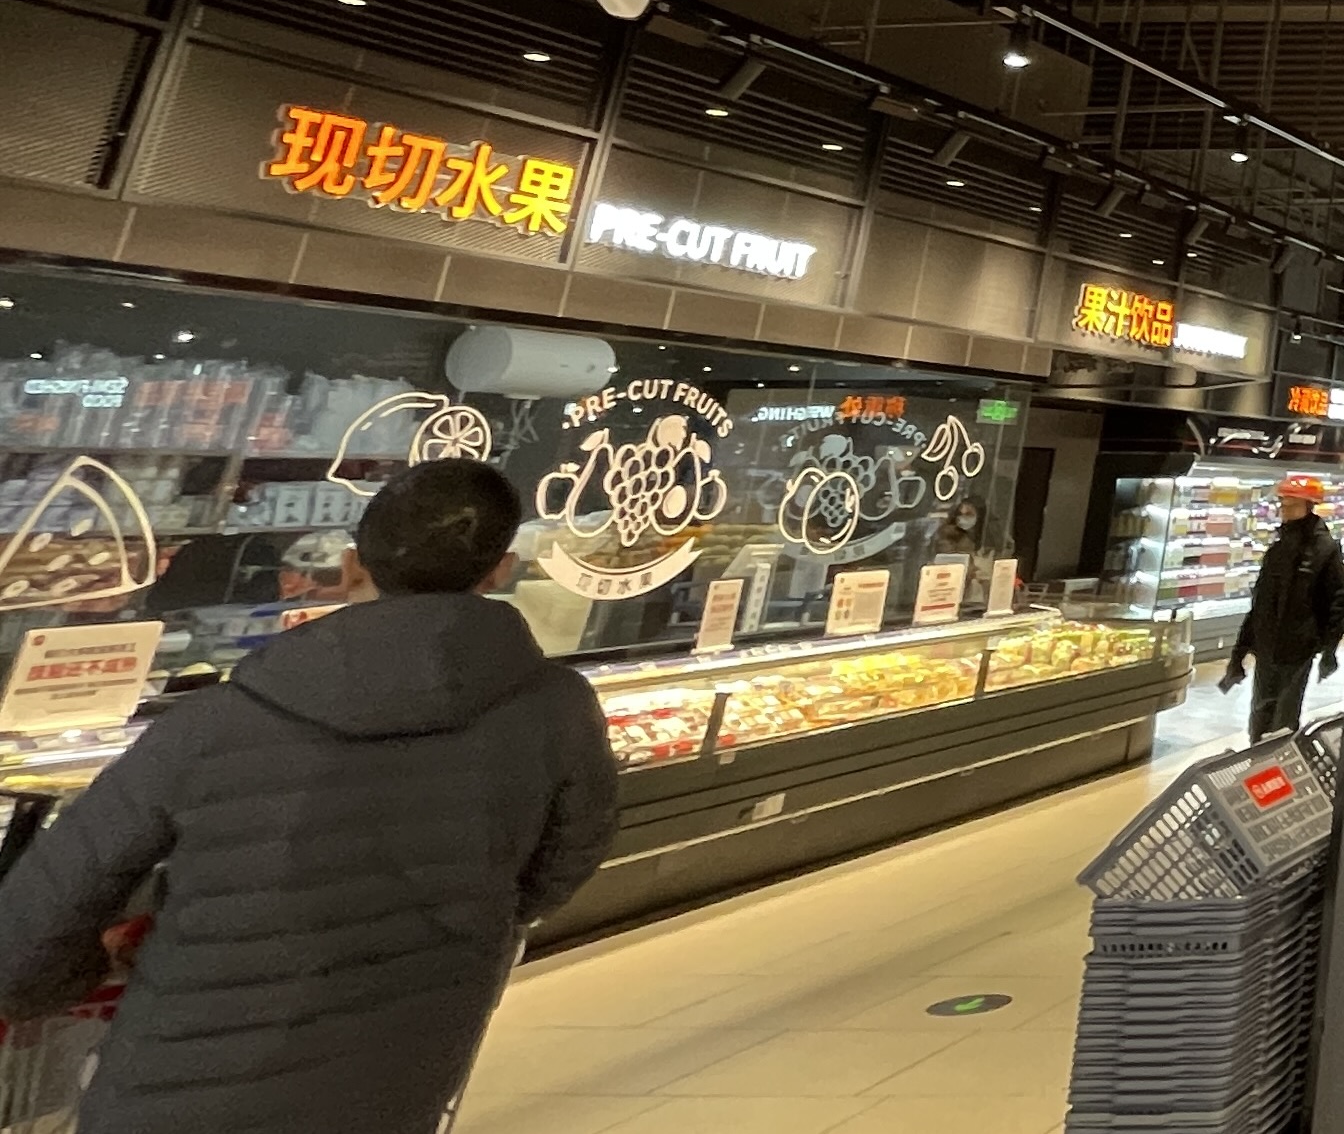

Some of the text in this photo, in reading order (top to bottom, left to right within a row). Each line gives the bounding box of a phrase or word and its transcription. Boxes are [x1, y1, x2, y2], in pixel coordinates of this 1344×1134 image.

[267, 106, 577, 235] 现切水果
[590, 203, 817, 280] PRE-CUT FRUIT
[1077, 285, 1174, 348] 果汁饮品
[569, 379, 734, 438] PRE-CUT FRUITS
